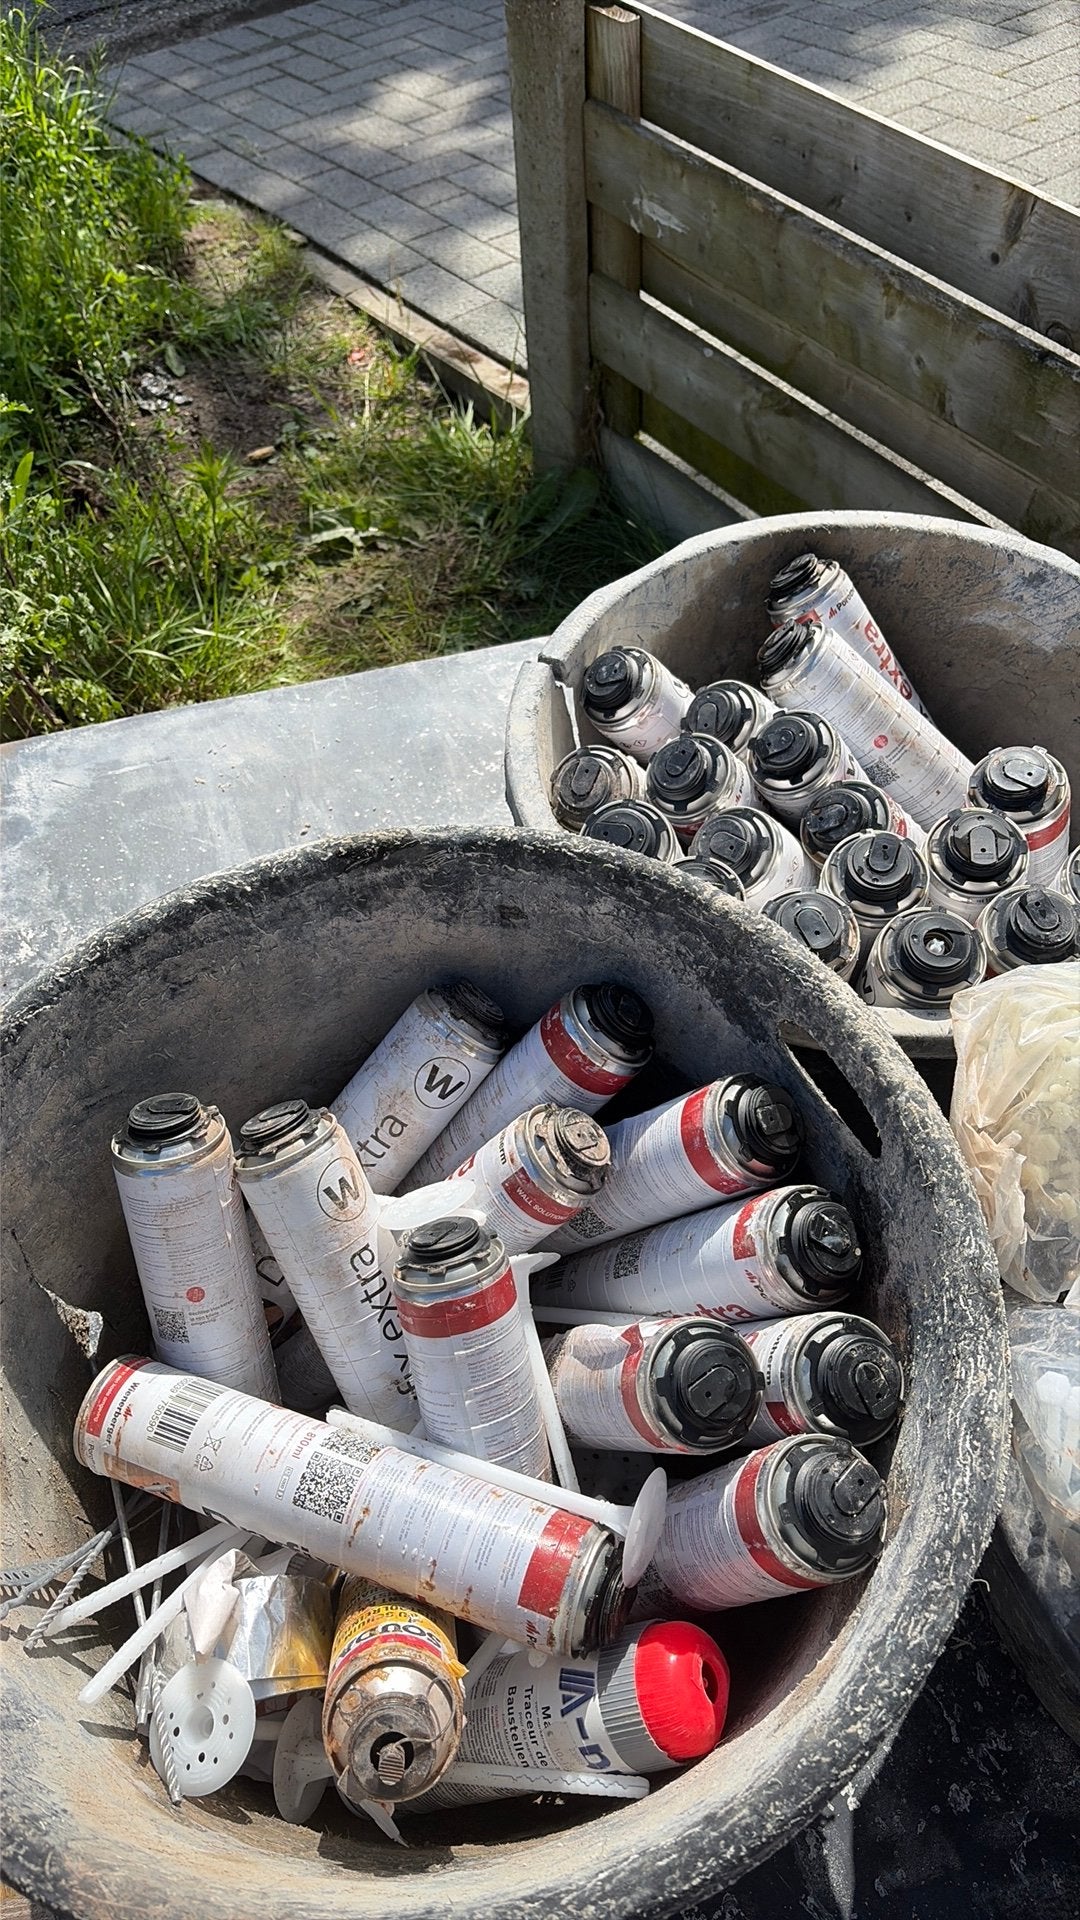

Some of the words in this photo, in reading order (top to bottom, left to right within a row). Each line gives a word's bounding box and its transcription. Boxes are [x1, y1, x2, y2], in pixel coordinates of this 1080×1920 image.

[864, 620, 913, 700] extra
[424, 1063, 465, 1101] W
[323, 1167, 360, 1211] W
[516, 1185, 532, 1206] WALL
[106, 1382, 140, 1445] Wienerberger
[146, 1400, 168, 1434] 750590
[292, 1446, 304, 1461] ml
[302, 1432, 316, 1447] 810
[507, 1685, 530, 1768] Baustellen
[524, 1684, 539, 1746] Traceur
[535, 1750, 548, 1767] de
